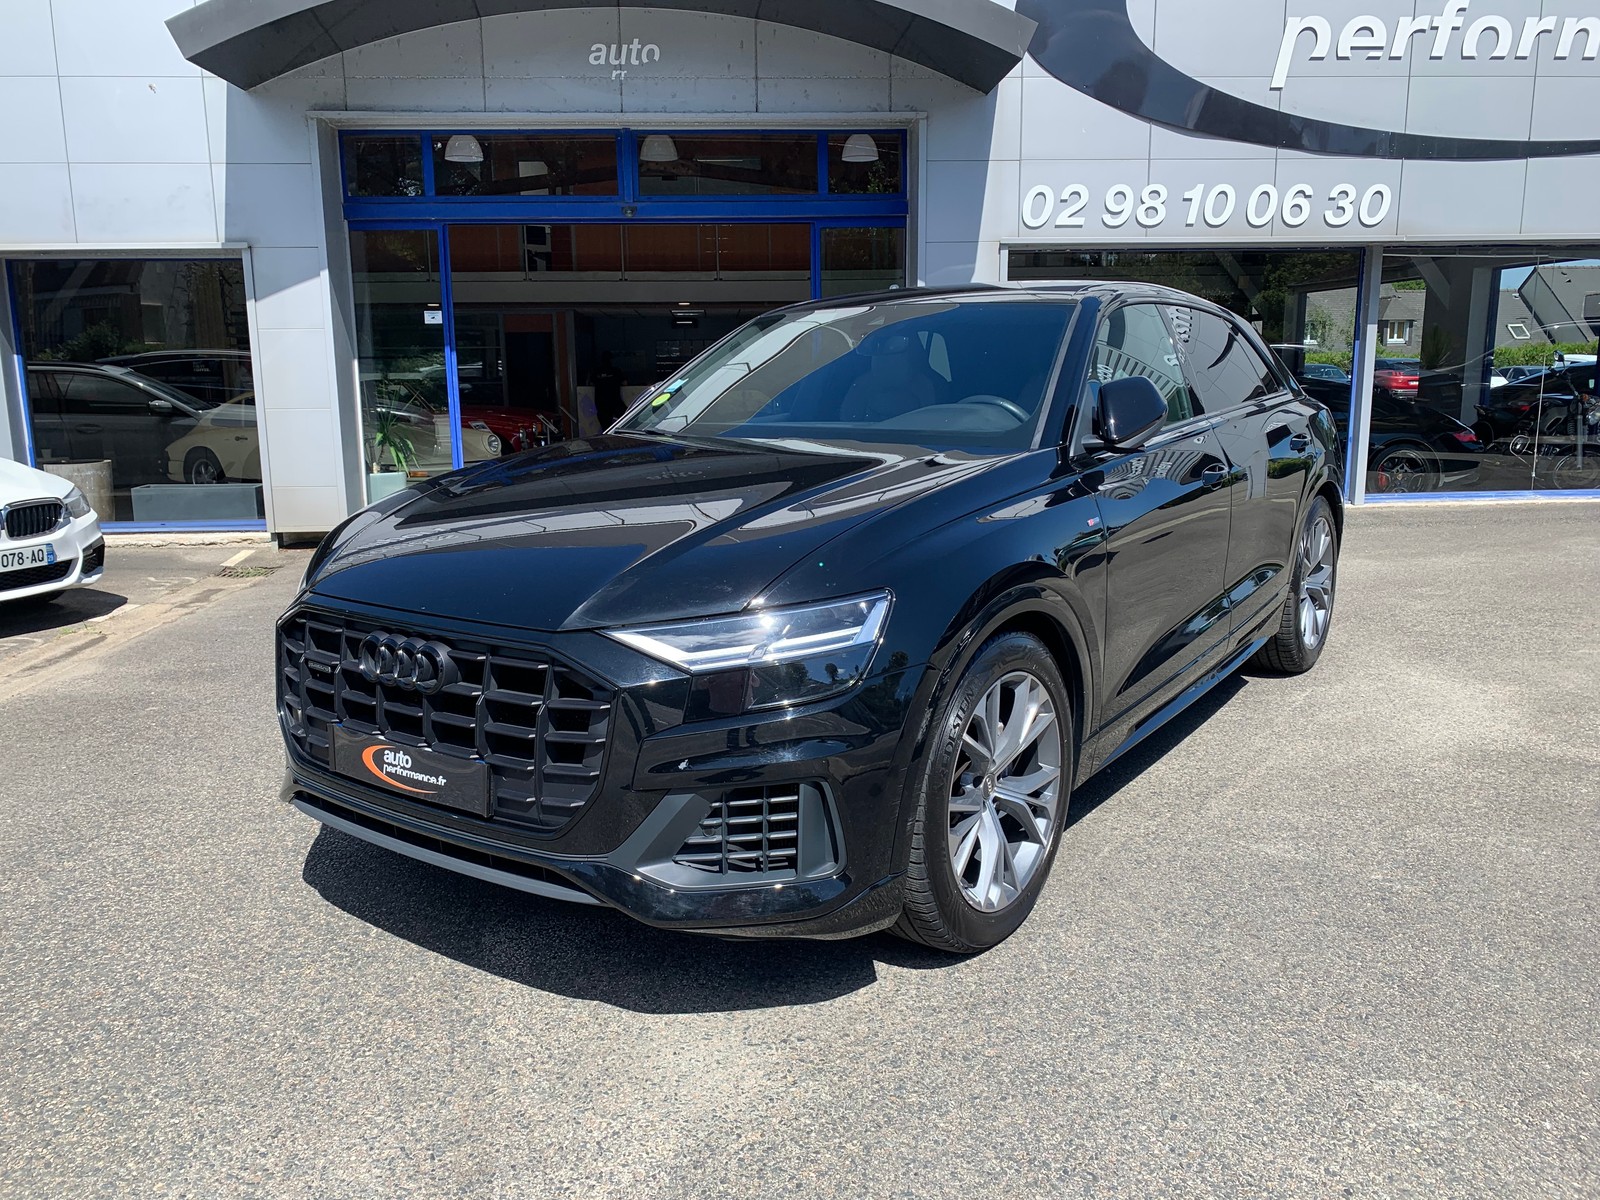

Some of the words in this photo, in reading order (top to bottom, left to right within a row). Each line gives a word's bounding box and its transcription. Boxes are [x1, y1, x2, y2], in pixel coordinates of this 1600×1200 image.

[588, 38, 660, 65] auto
[1022, 183, 1089, 229] 02
[1101, 183, 1168, 229] 98
[1182, 183, 1236, 228] 10
[1246, 183, 1314, 228] 06
[1323, 183, 1392, 228] 30
[383, 749, 412, 769] auto
[383, 763, 447, 786] performance.fr
